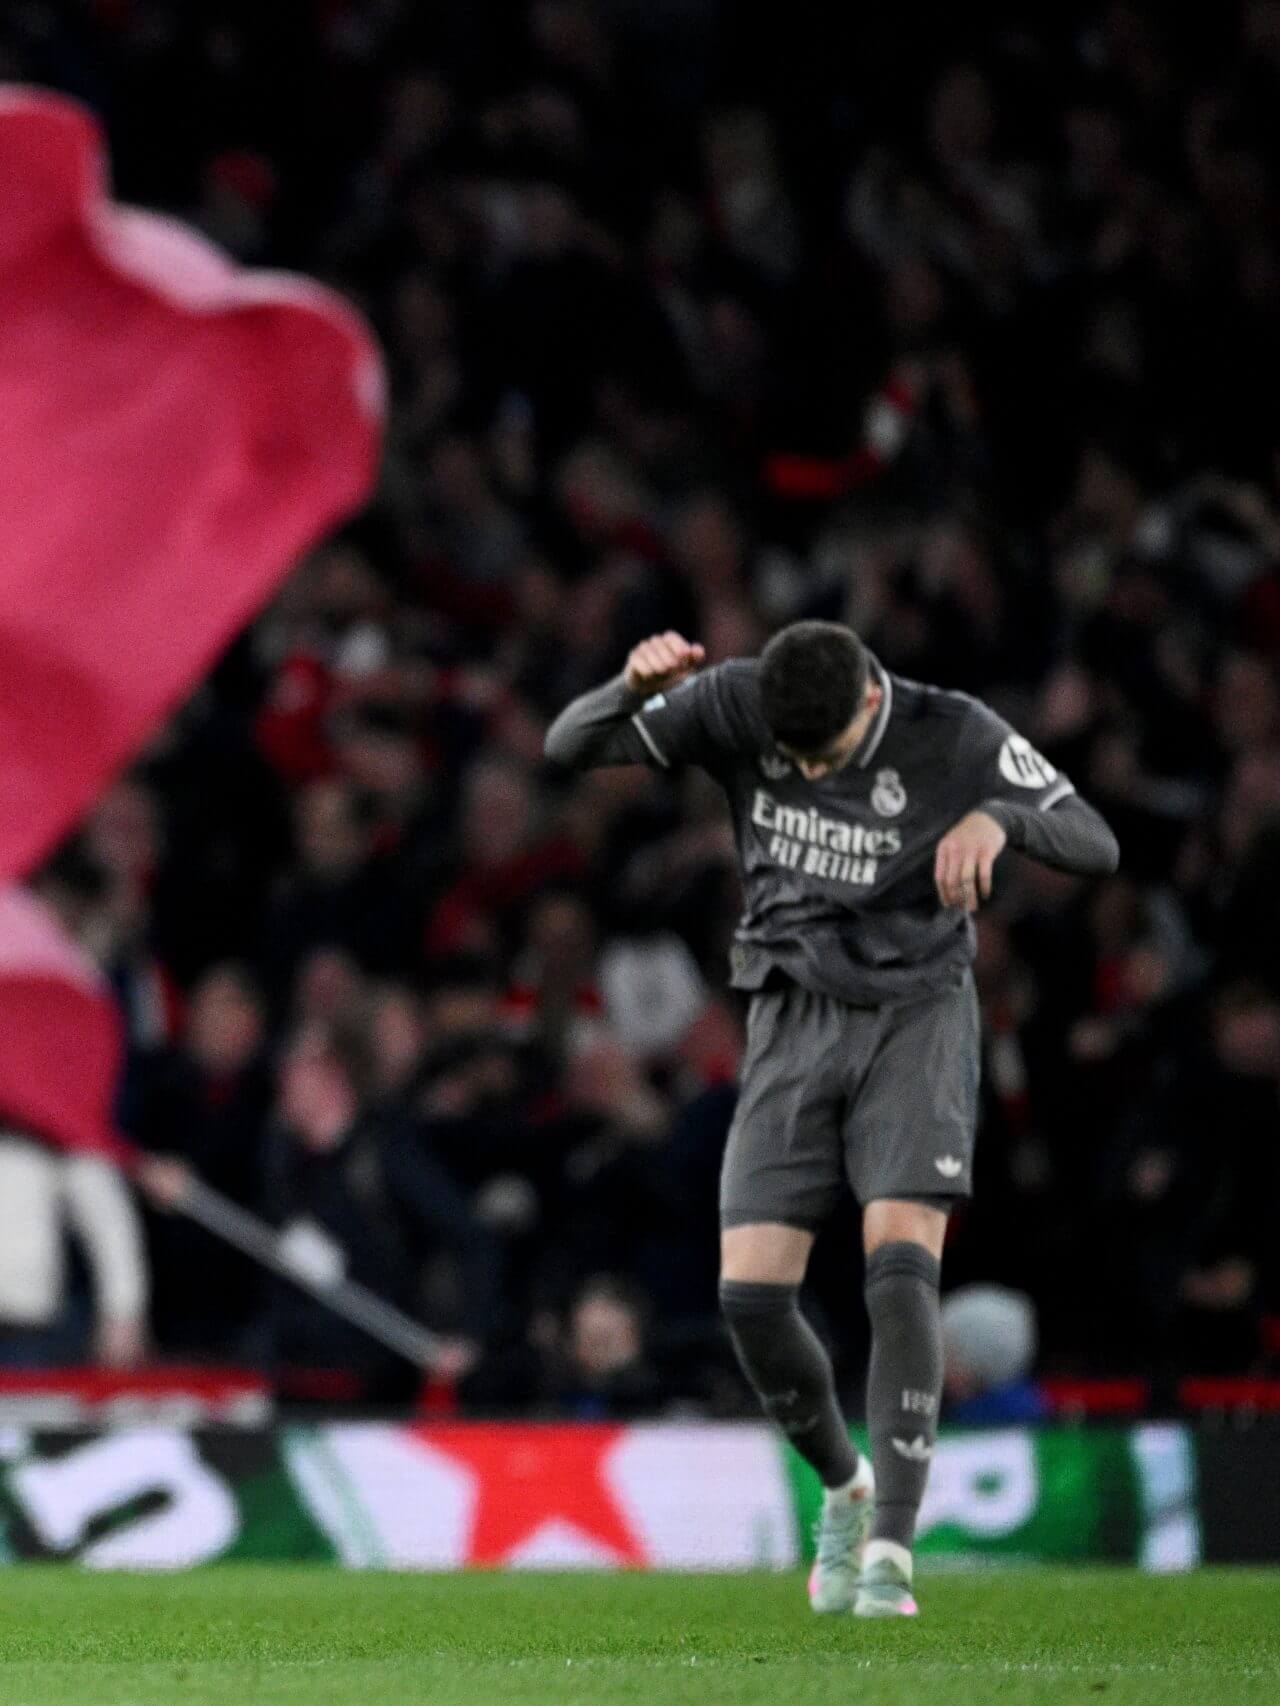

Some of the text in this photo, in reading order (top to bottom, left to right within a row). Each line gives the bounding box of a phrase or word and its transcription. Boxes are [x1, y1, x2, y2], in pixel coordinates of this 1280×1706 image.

[752, 789, 902, 857] Emirates
[770, 833, 878, 886] FLY BETTER
